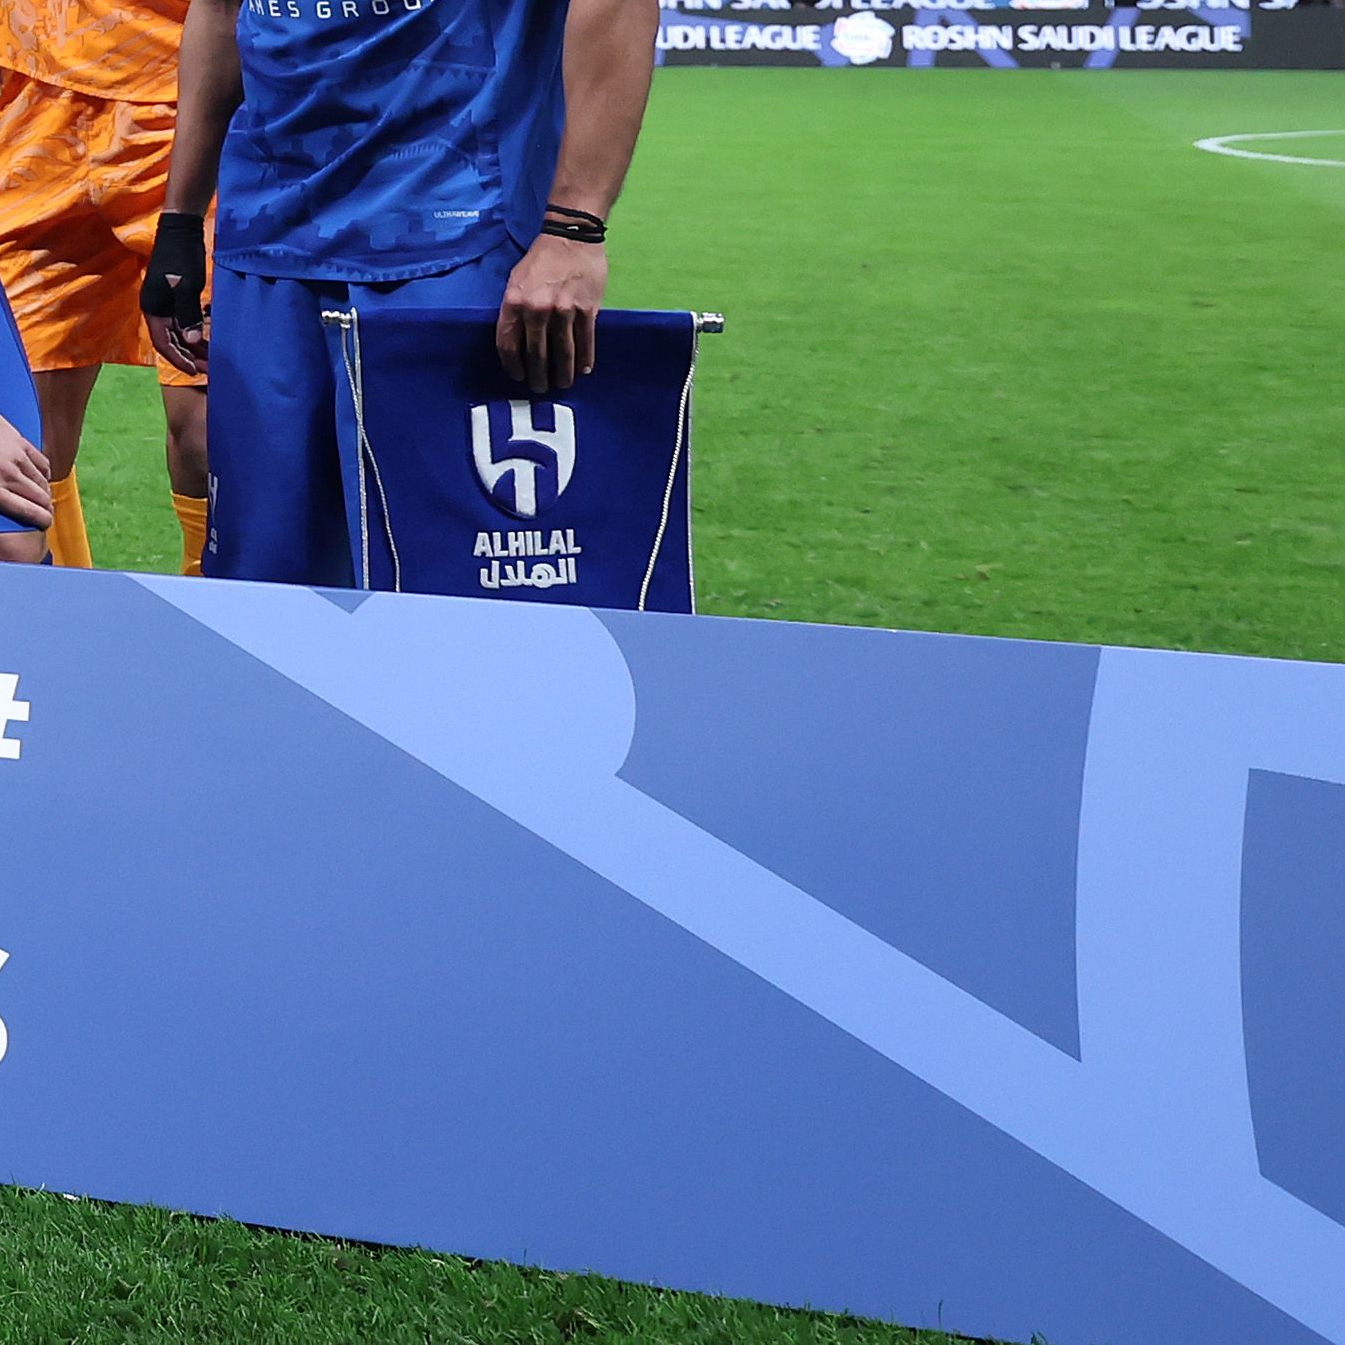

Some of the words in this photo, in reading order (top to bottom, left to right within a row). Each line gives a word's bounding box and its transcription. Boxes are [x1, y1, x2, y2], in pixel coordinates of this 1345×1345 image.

[659, 26, 706, 50] UDI
[711, 25, 823, 51] LEAGUE
[902, 25, 1013, 51] ROSHN
[1017, 25, 1110, 51] SAUDI
[1118, 25, 1244, 52] LEAGUE
[473, 529, 581, 557] ALHILAL
[479, 557, 577, 589] الهلال
